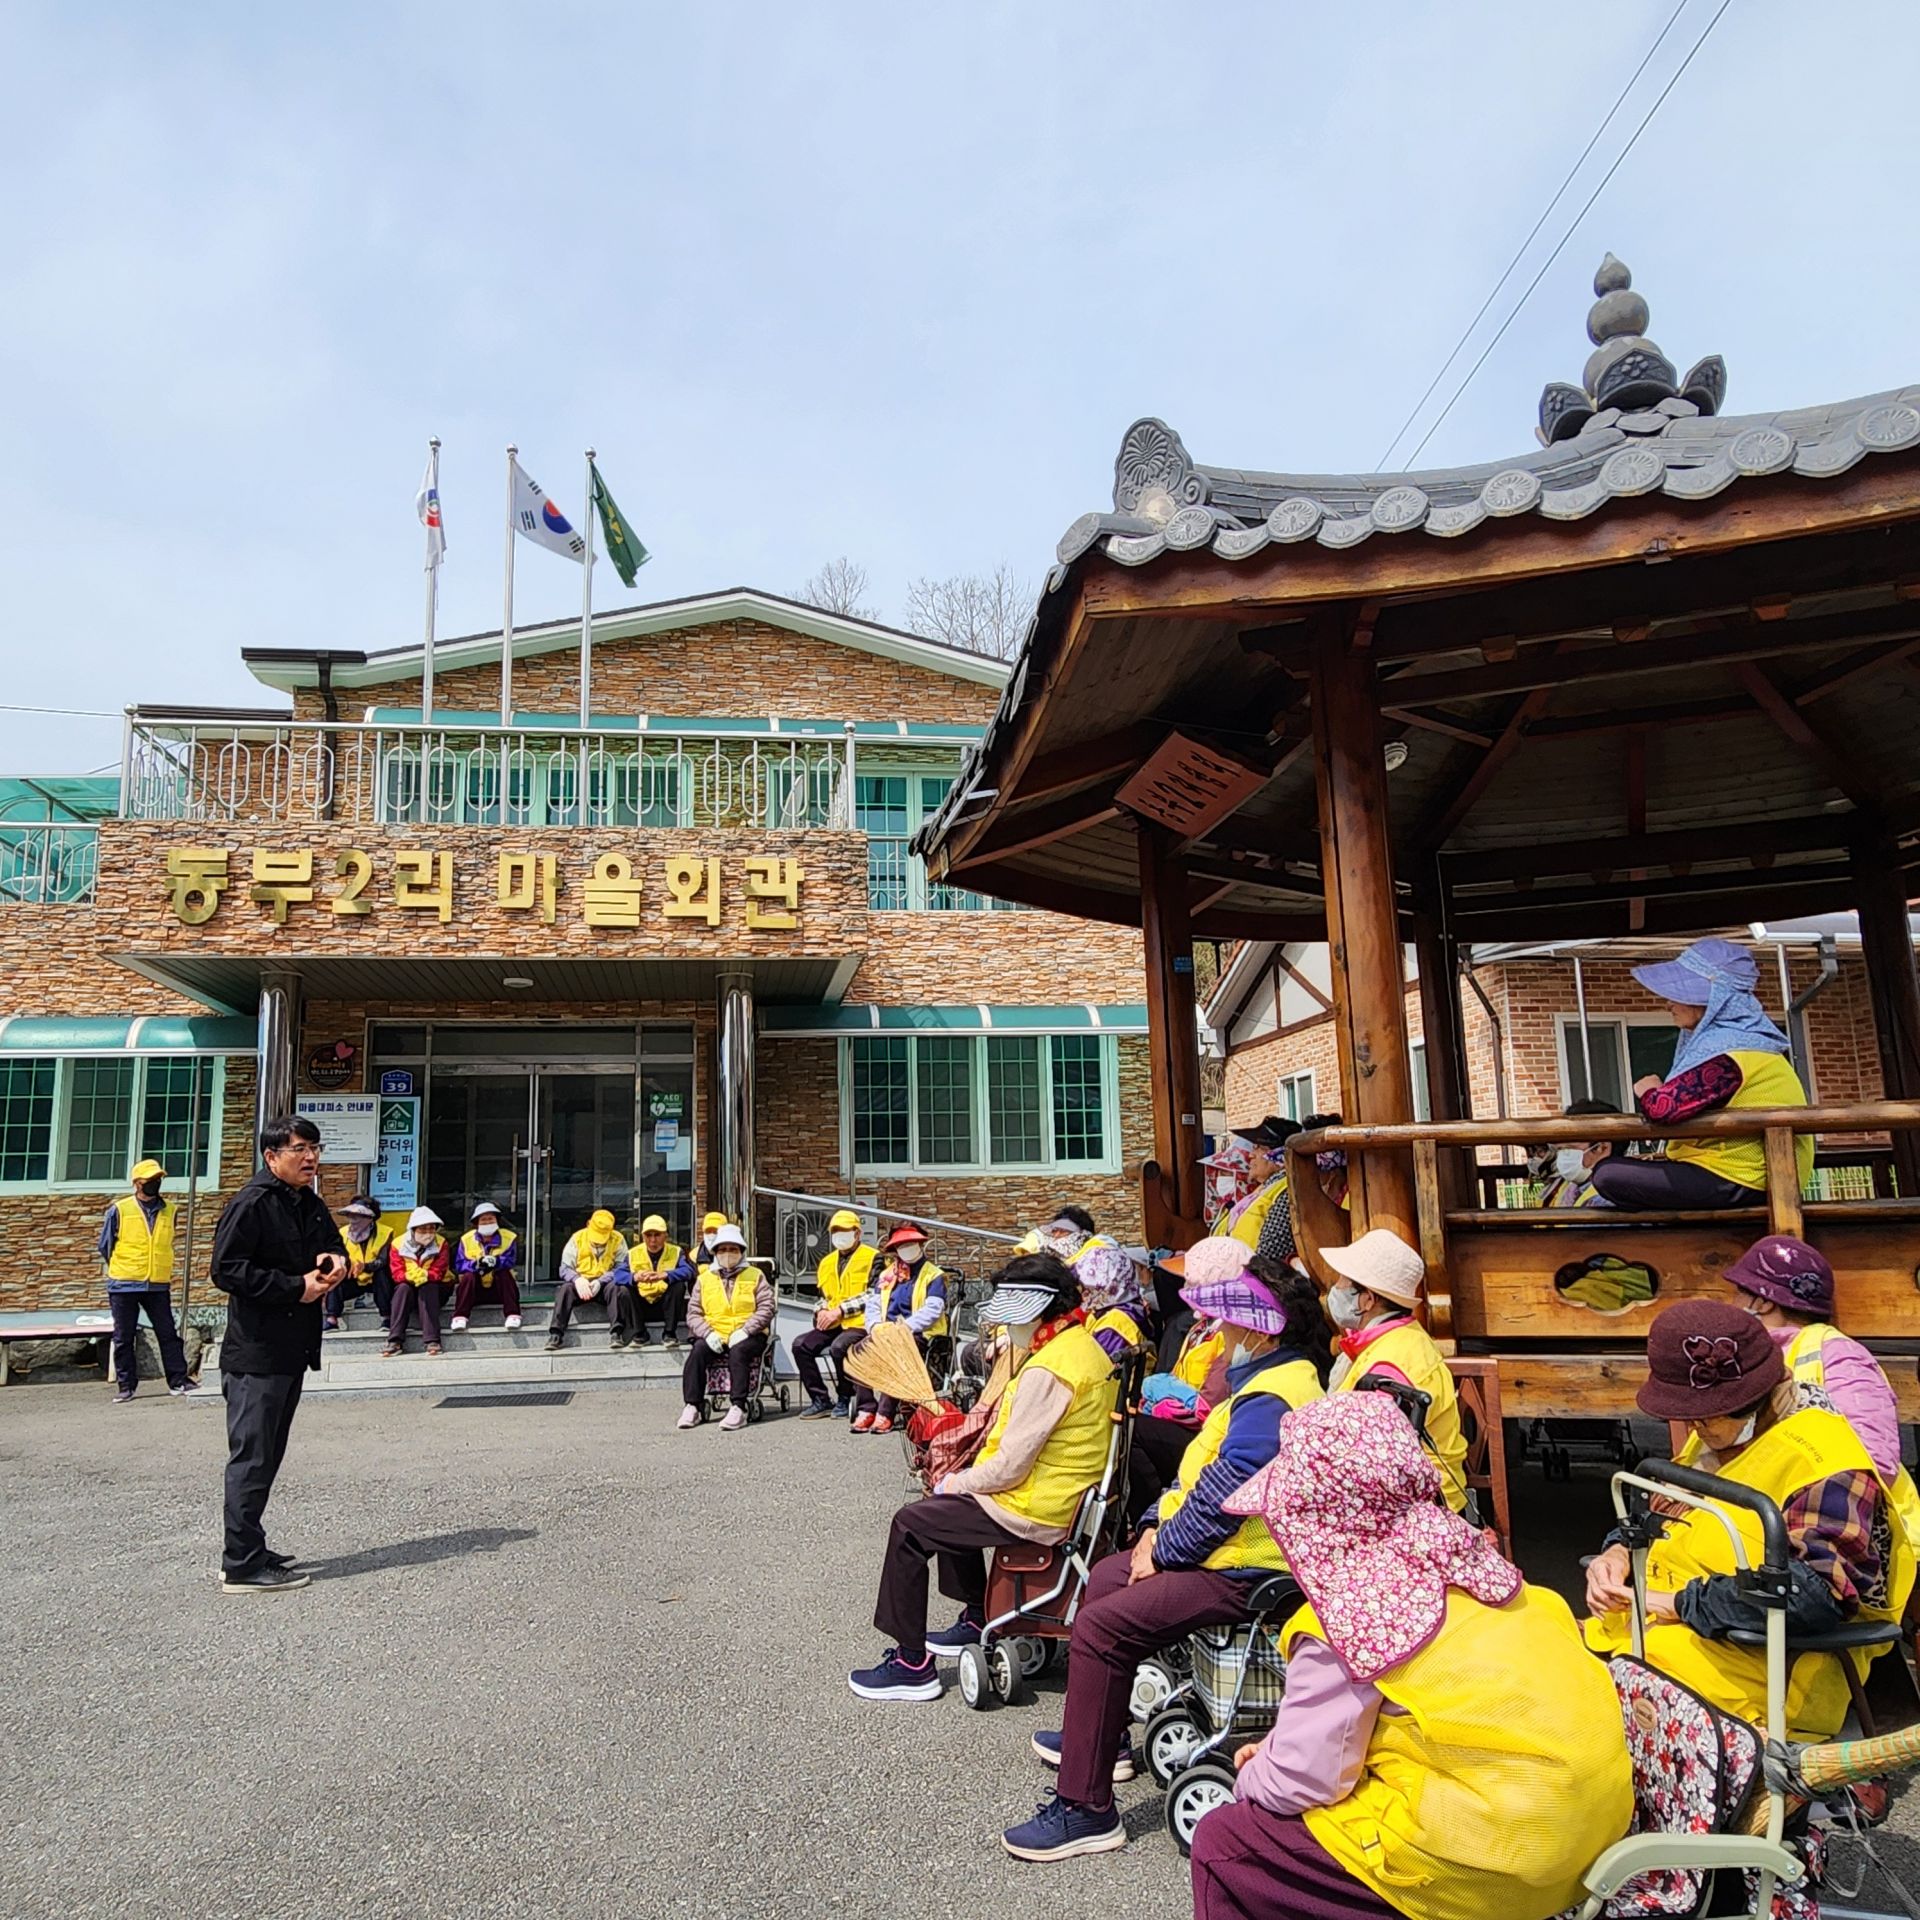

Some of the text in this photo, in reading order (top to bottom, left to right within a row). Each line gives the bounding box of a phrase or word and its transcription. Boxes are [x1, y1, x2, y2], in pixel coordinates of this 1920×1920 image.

[164, 846, 805, 930] 동부2리 마을회관
[386, 1082, 407, 1092] 39
[663, 1093, 680, 1101] AED
[298, 1102, 374, 1113] 마을대피소 안내문
[379, 1138, 414, 1152] 무더위
